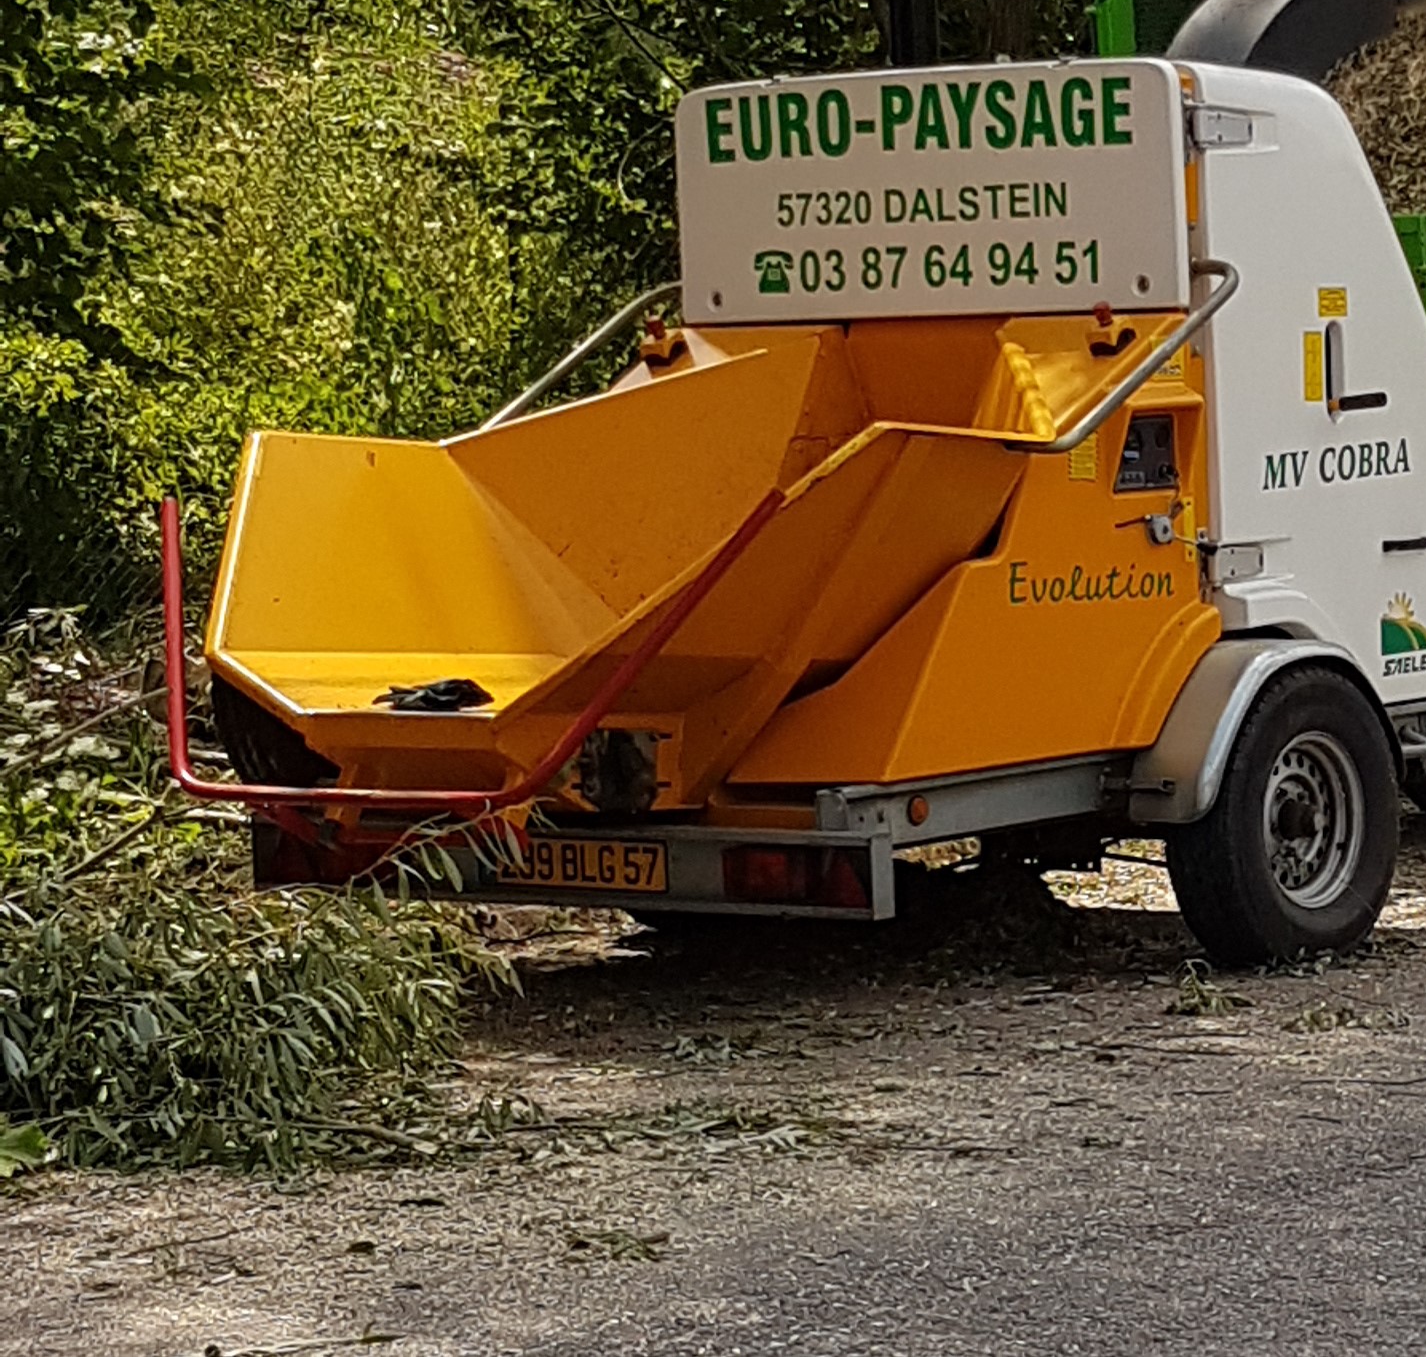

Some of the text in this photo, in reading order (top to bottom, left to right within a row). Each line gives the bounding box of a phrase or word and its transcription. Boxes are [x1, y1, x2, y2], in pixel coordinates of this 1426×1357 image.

[705, 76, 1133, 164] EURO-PAYSAGE
[777, 182, 1068, 227] 57320 DALSTEIN
[800, 240, 1099, 292] 03 87 64 94 51
[1262, 438, 1410, 490] MV COBRA
[1009, 562, 1174, 604] Evolution
[561, 844, 616, 884] BLG
[624, 846, 659, 886] 57
